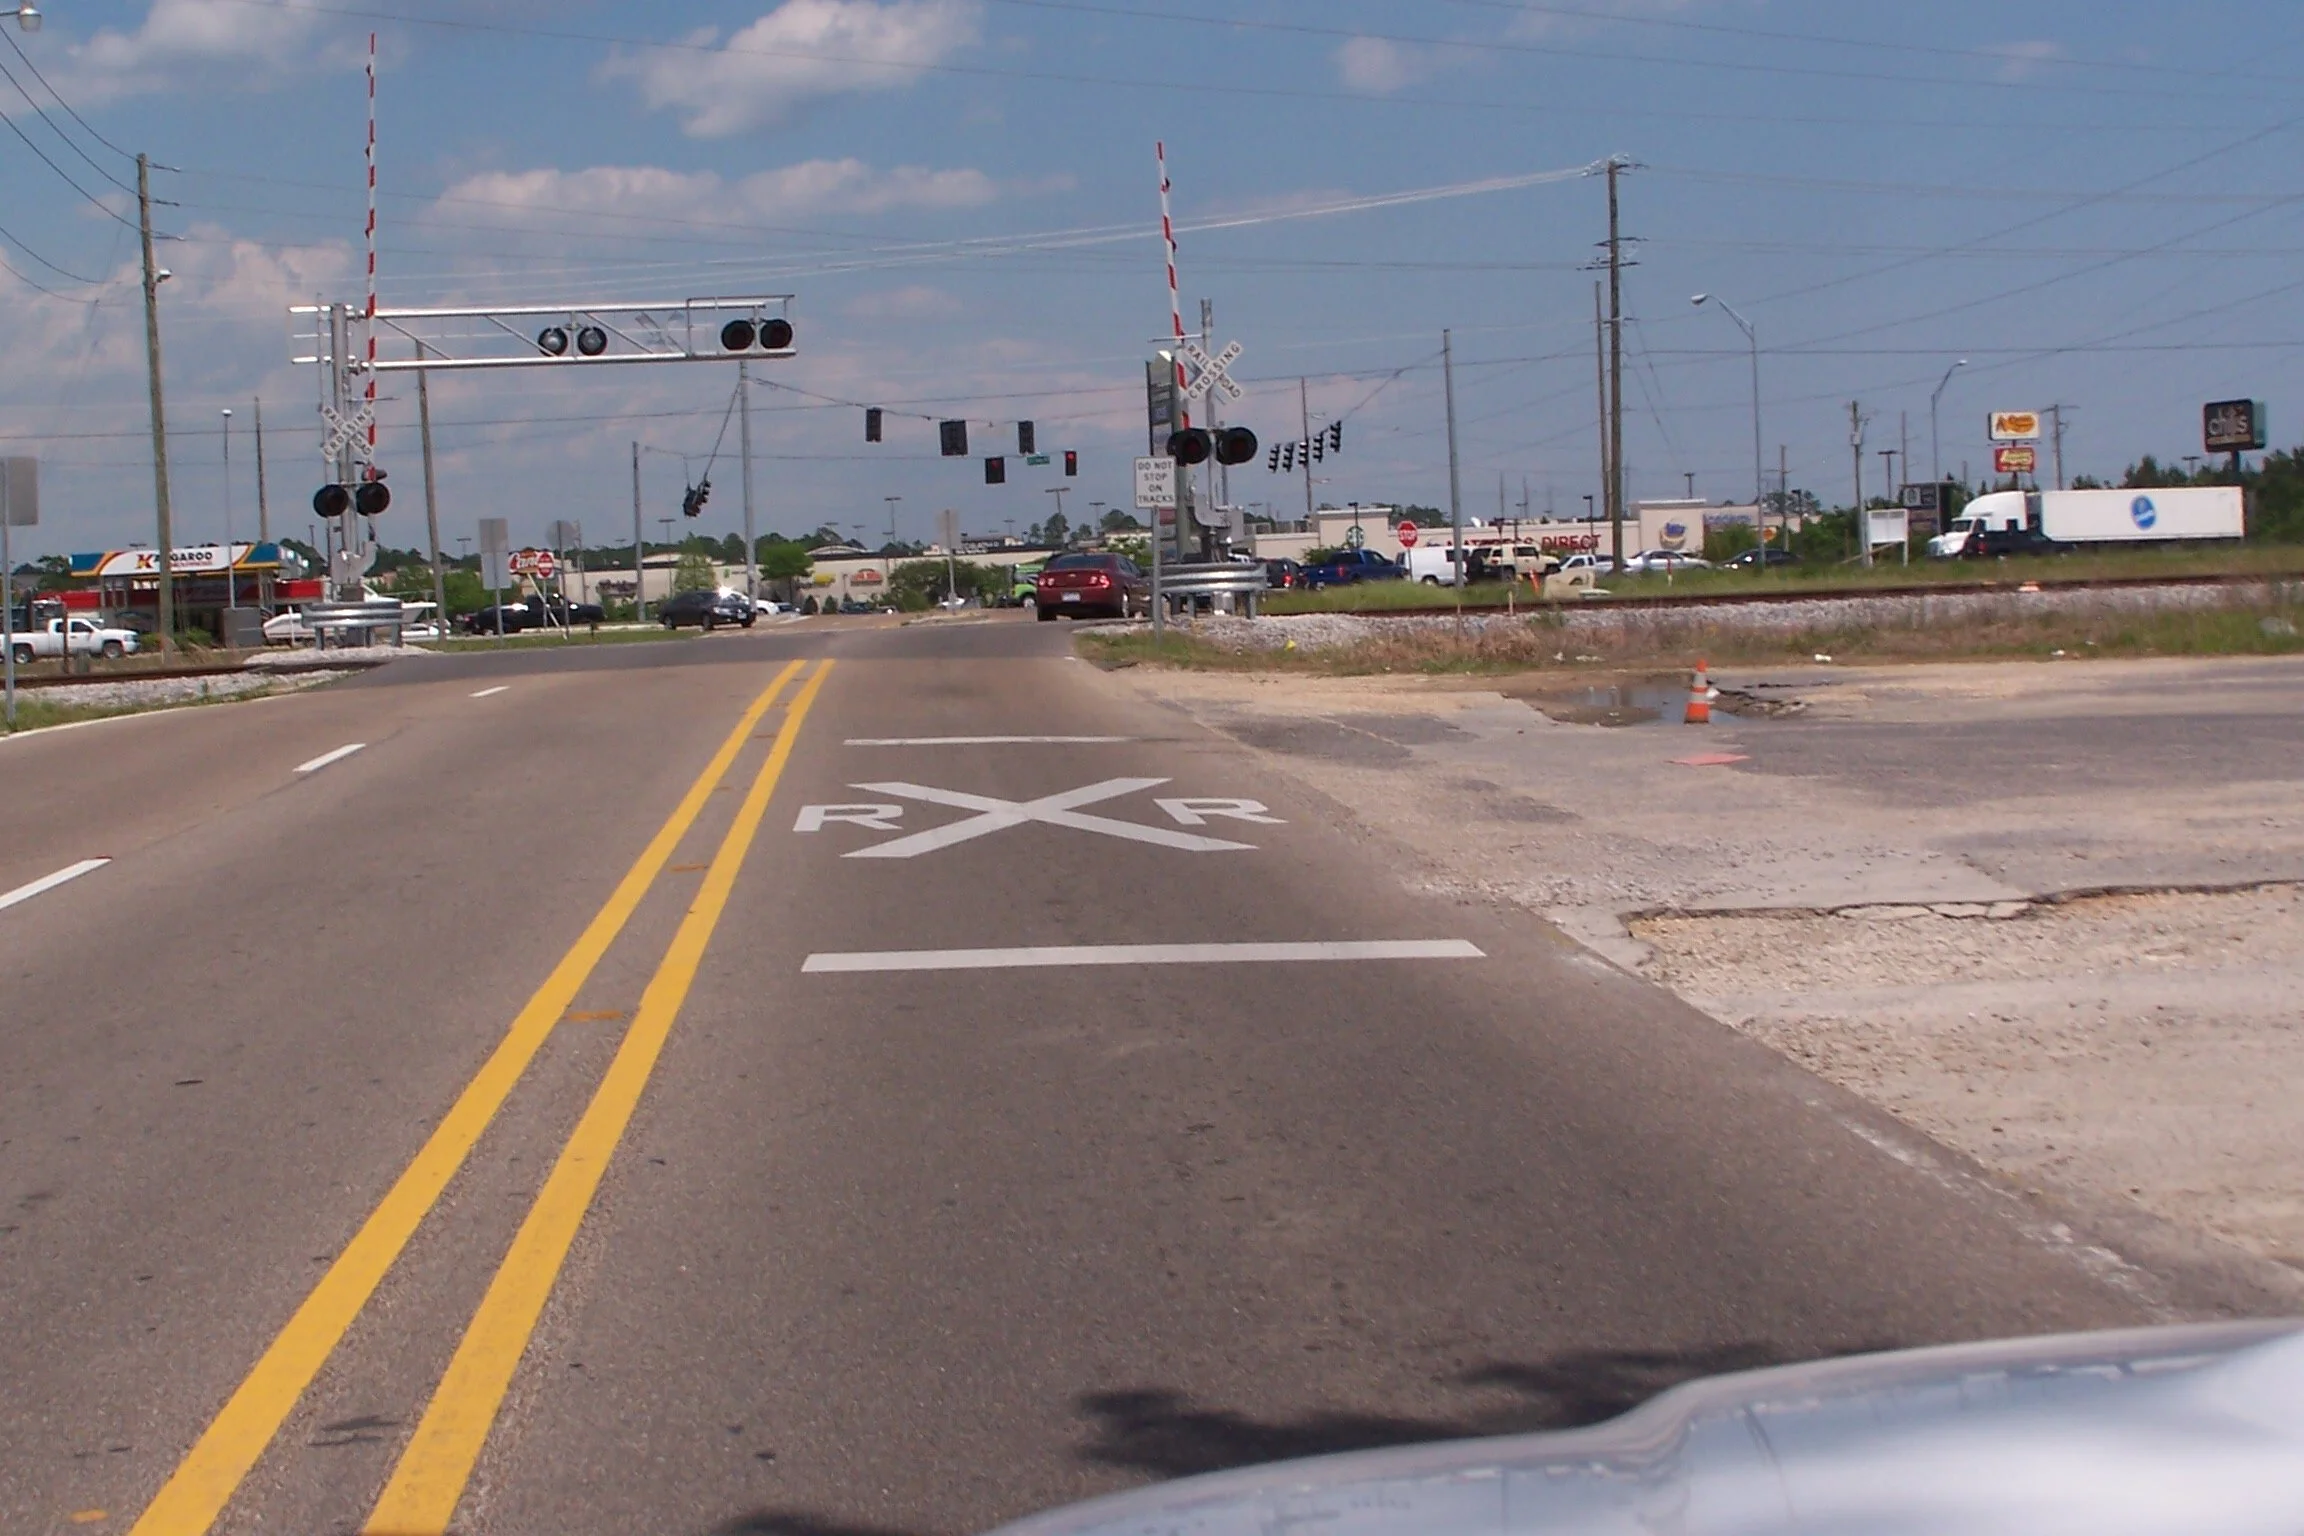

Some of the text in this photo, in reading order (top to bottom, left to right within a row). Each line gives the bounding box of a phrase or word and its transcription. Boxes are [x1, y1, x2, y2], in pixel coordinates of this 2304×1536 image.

[1187, 344, 1242, 399] RAIL ROAD
[1188, 343, 1241, 399] CROSSING
[1138, 460, 1173, 471] DO NOT
[1143, 472, 1168, 482] STOP
[1149, 484, 1163, 493] ON
[1137, 494, 1174, 504] TRACKS
[1399, 529, 1417, 541] STOP
[1541, 534, 1602, 550] DIRECT
